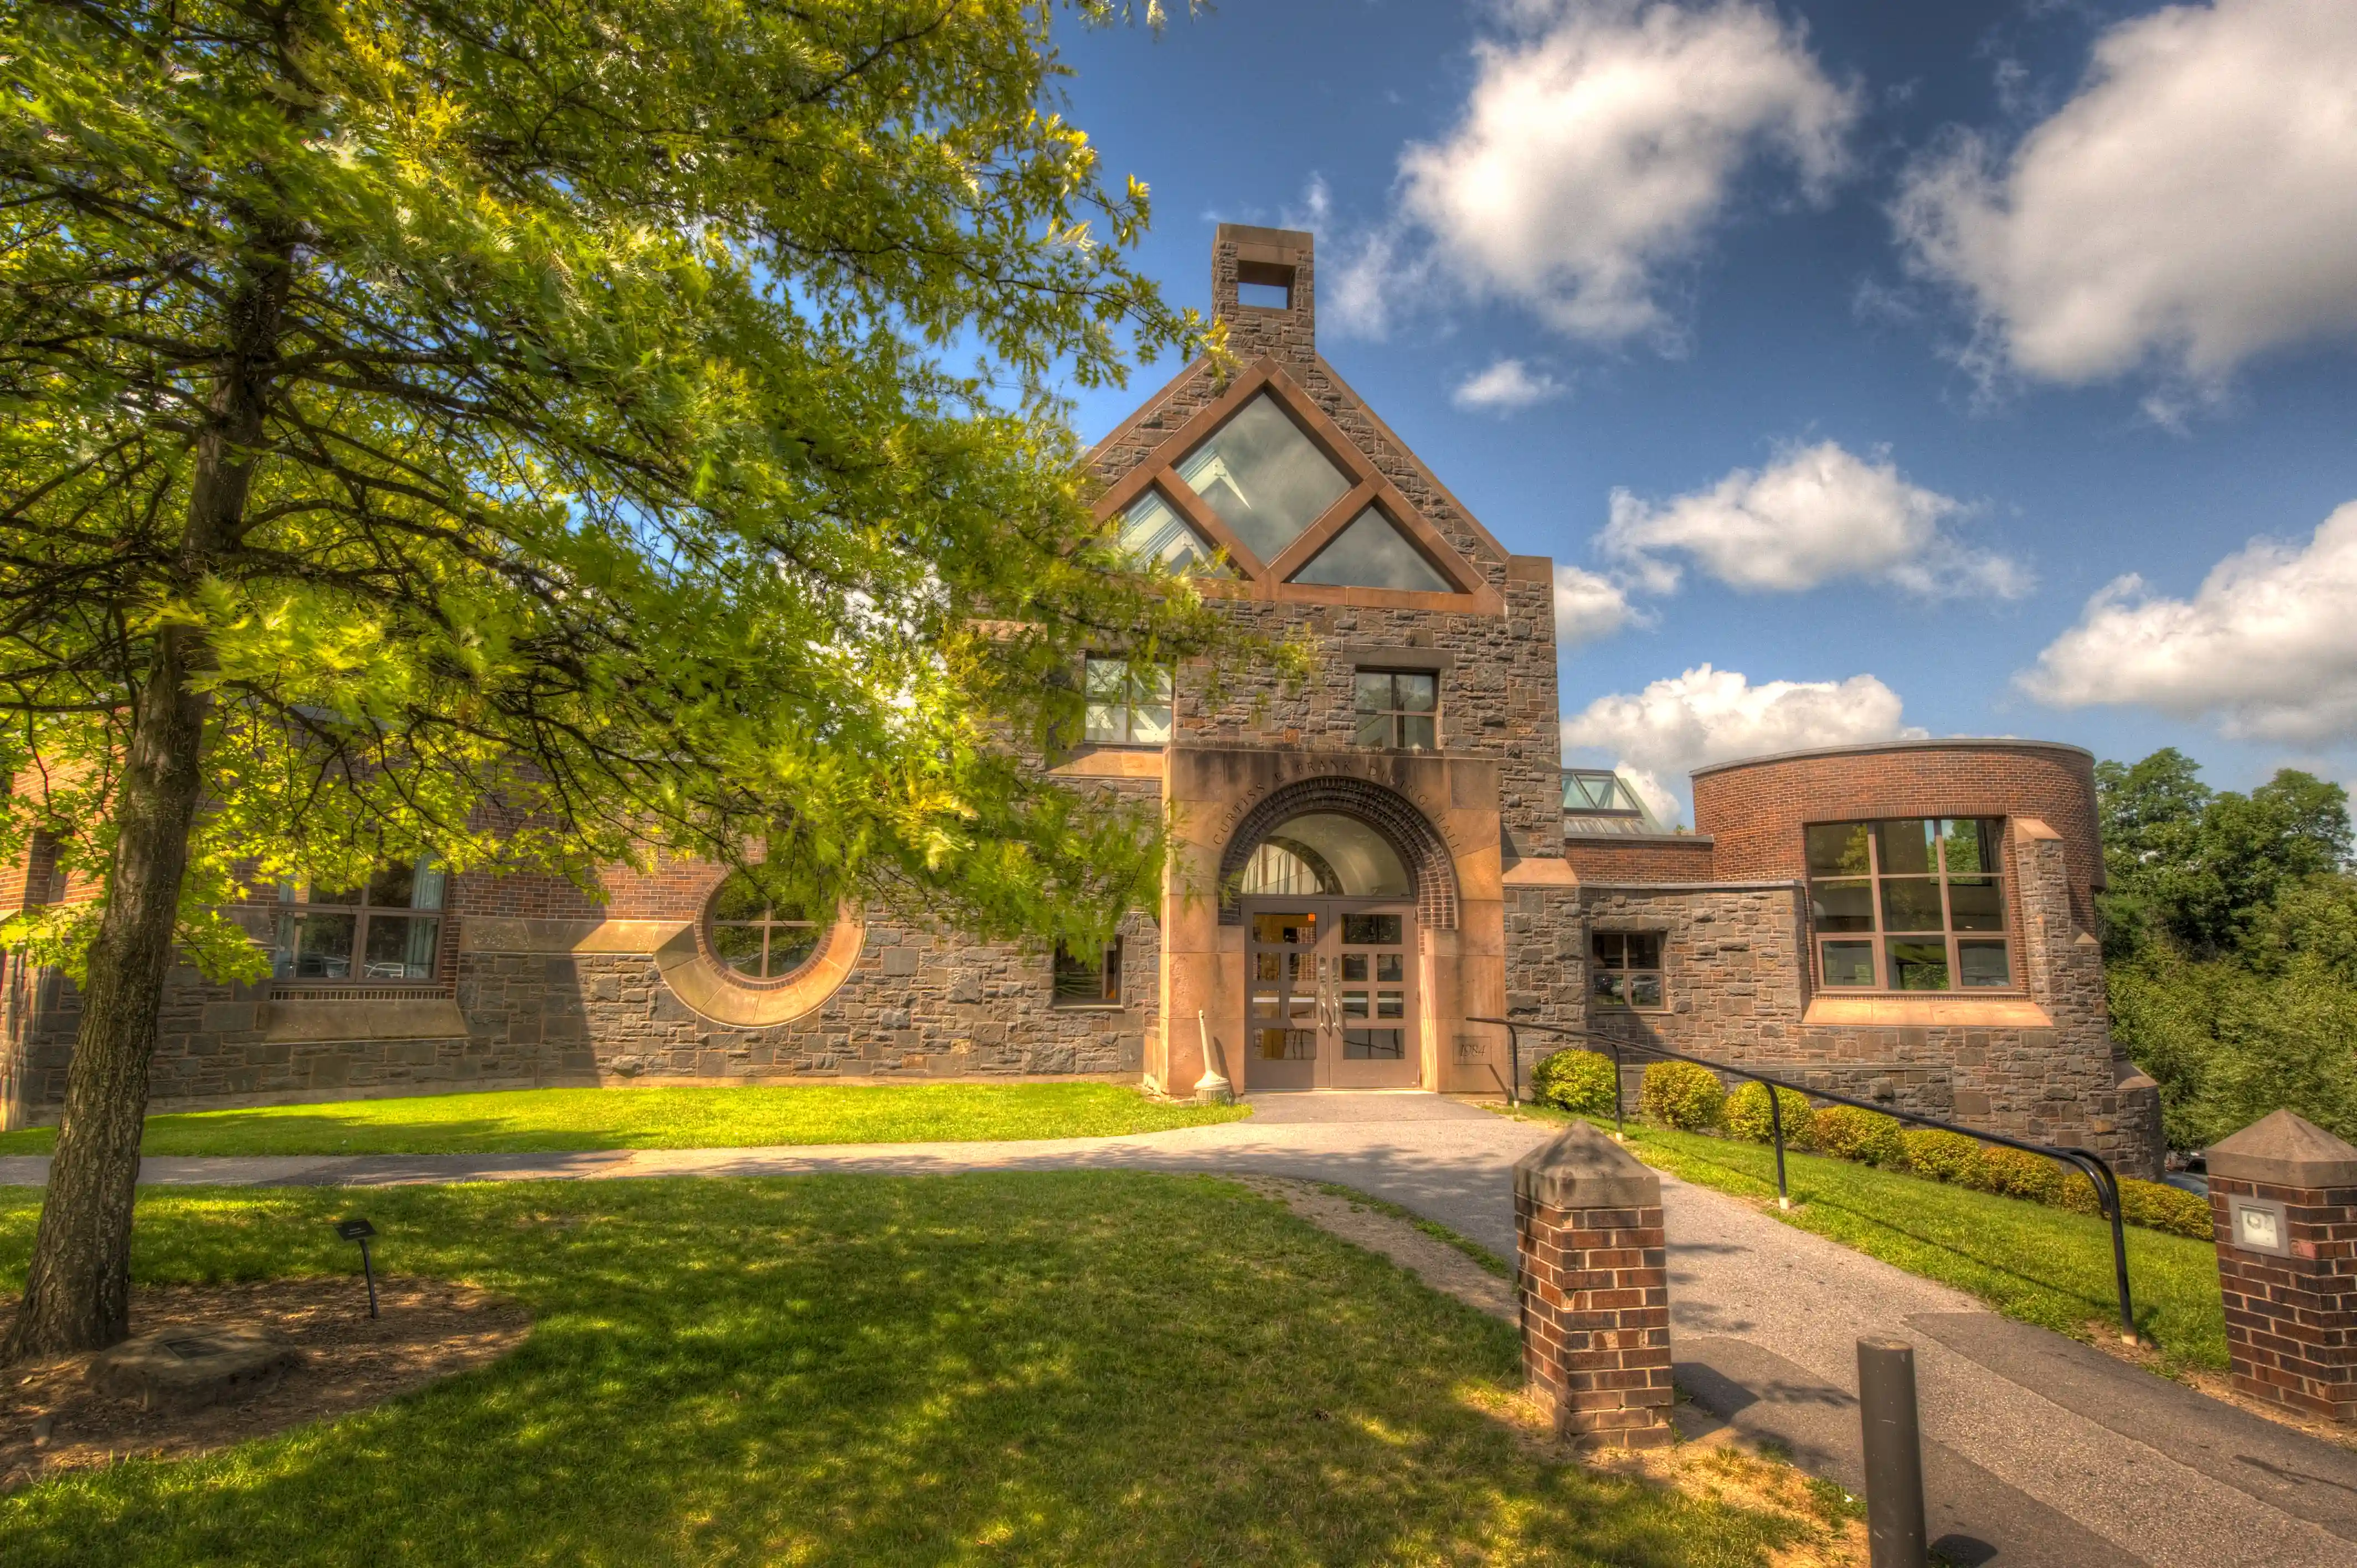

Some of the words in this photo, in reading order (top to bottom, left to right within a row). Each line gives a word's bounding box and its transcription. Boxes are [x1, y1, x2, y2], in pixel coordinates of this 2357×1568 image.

[1213, 782, 1265, 845] CURTISS
[1296, 760, 1351, 775] FRANK
[1366, 766, 1429, 806] DIING
[1434, 812, 1460, 853] HALL
[1459, 1044, 1486, 1057] 1984
